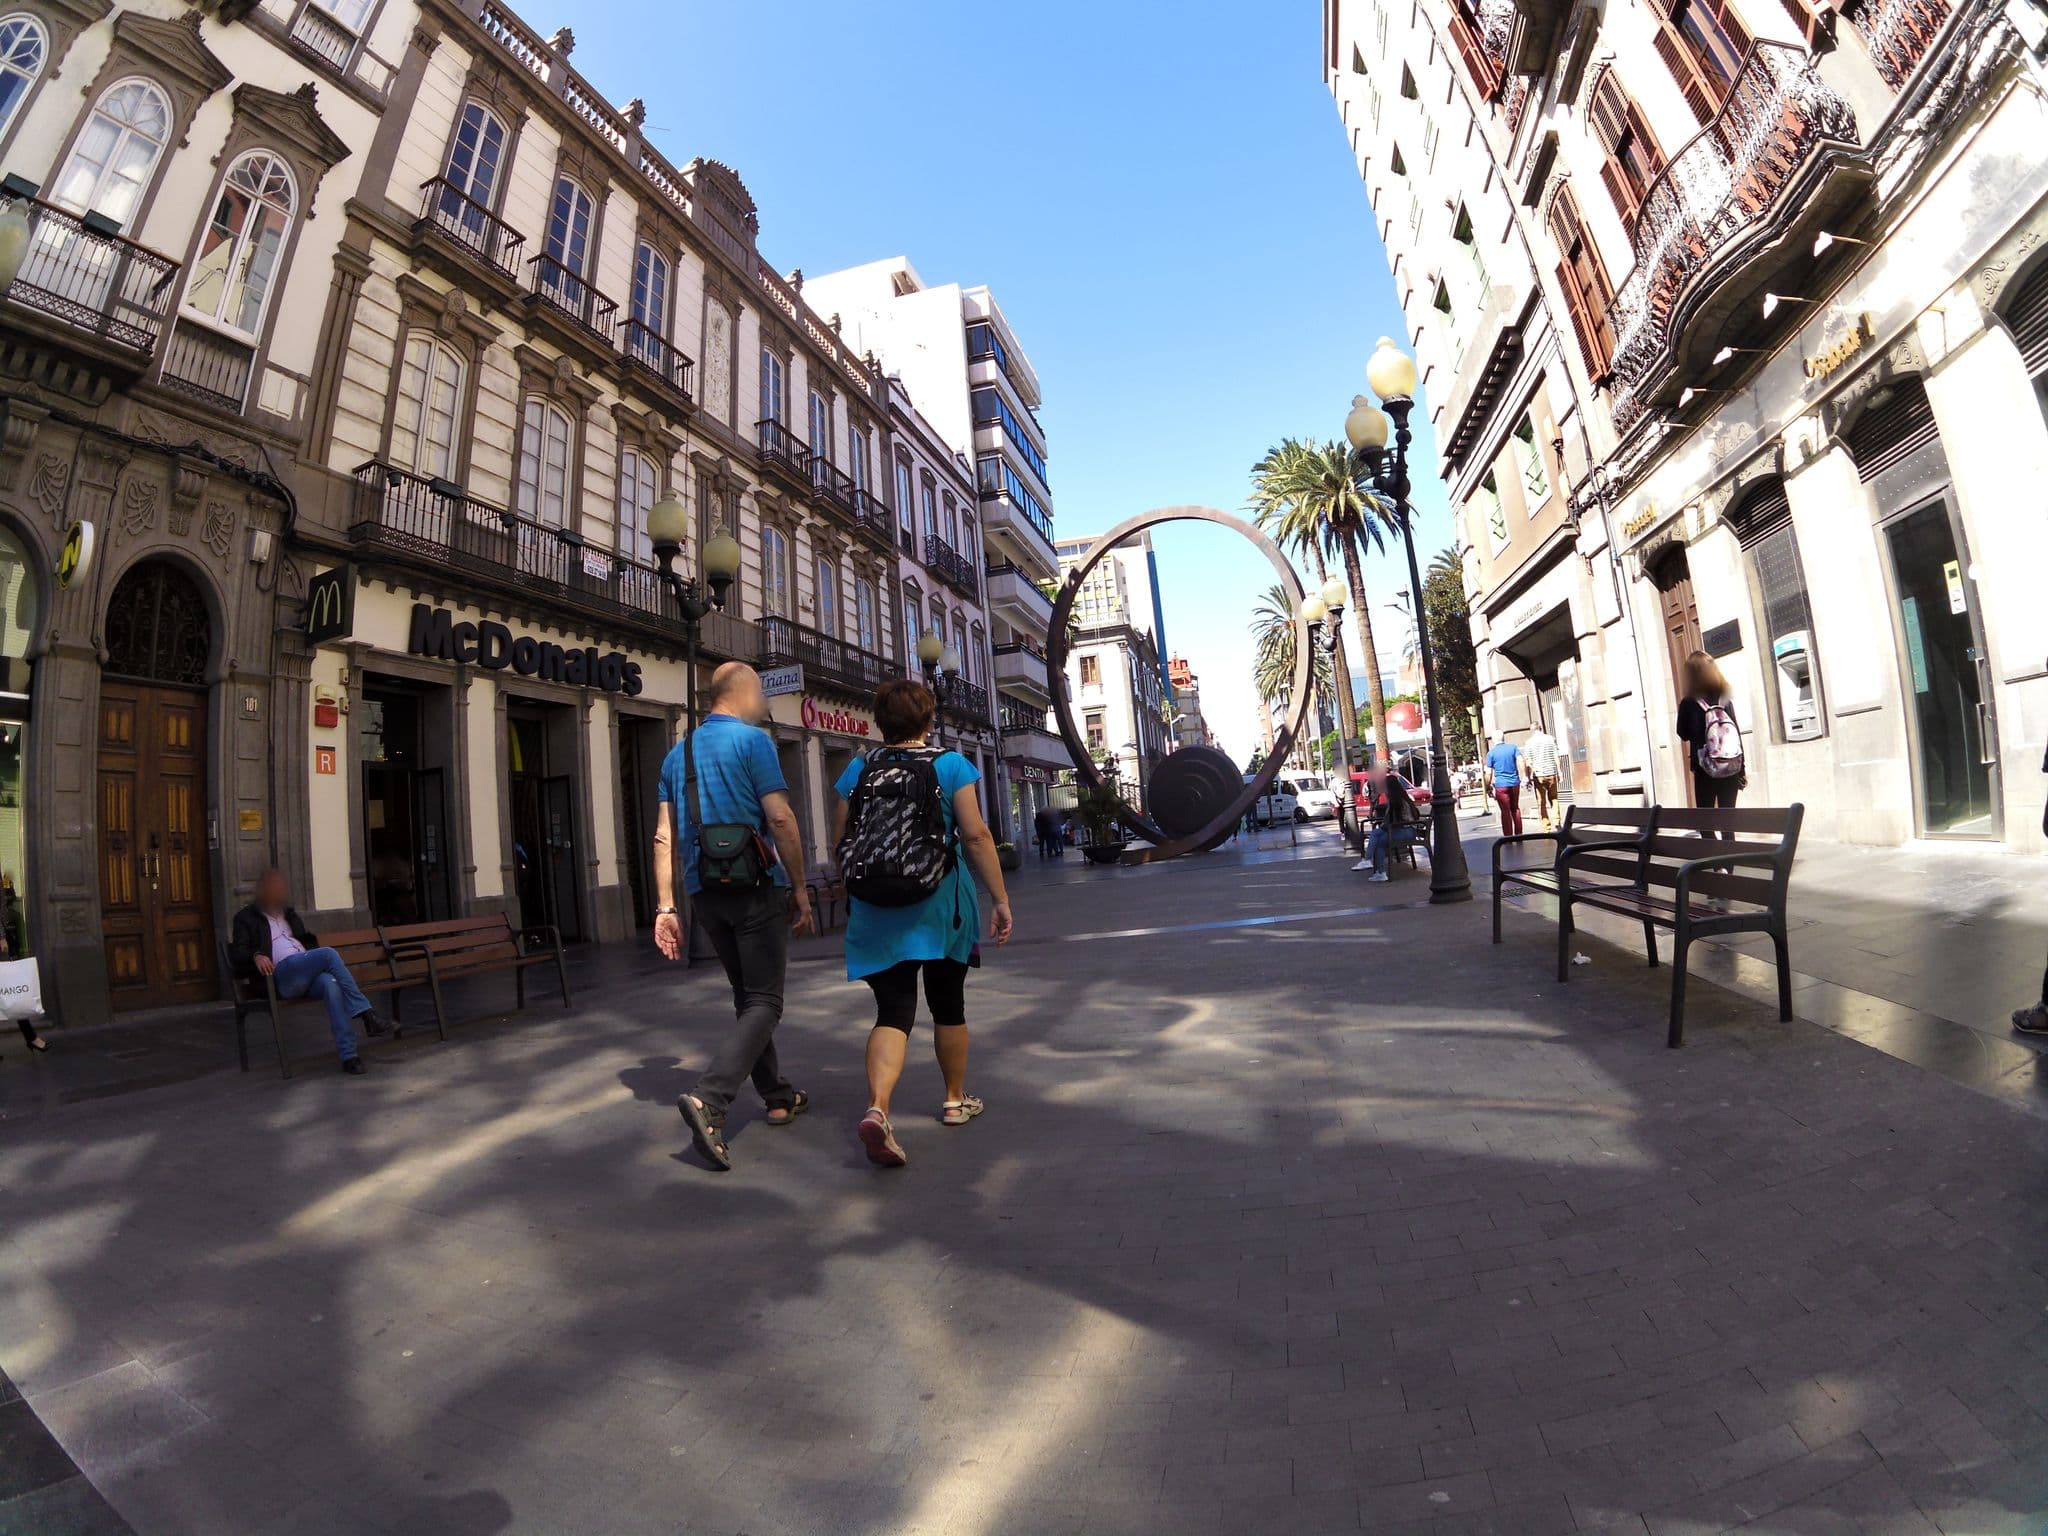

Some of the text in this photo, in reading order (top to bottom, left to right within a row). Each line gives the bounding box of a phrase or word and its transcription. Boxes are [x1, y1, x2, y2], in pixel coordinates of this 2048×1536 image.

[408, 603, 643, 697] McDonald's
[245, 696, 258, 711] 101
[818, 709, 870, 737] vodafone
[321, 753, 331, 771] R
